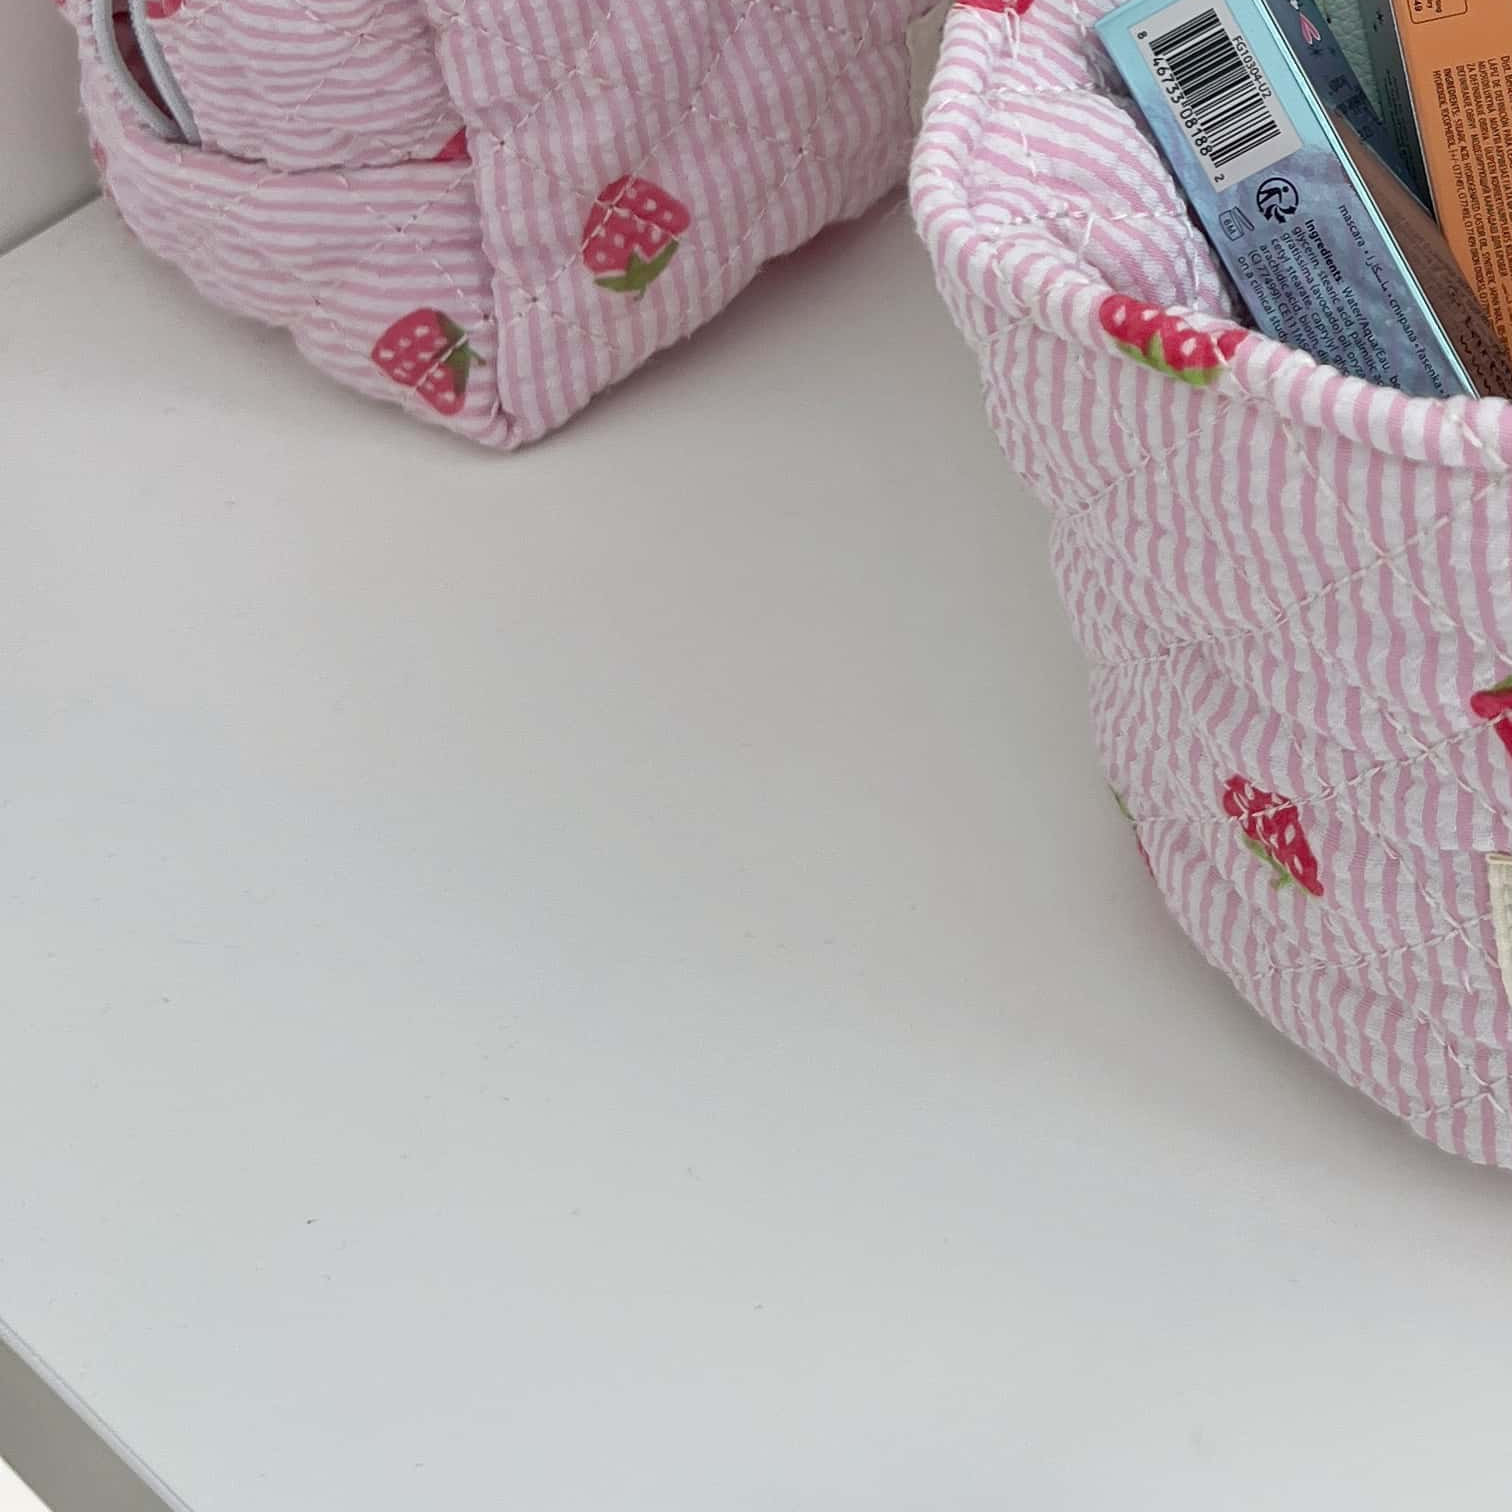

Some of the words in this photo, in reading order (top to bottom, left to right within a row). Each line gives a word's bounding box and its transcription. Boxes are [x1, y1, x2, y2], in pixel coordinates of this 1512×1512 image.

[1230, 34, 1274, 100] FG10304-U2
[1136, 29, 1148, 41] 8
[1149, 54, 1186, 105] 46733
[1177, 106, 1214, 157] 08188
[1213, 172, 1225, 183] 2
[1337, 203, 1367, 248] mascara
[1237, 254, 1251, 271] on
[1250, 278, 1275, 314] clinical
[1308, 281, 1344, 335] (avocado)
